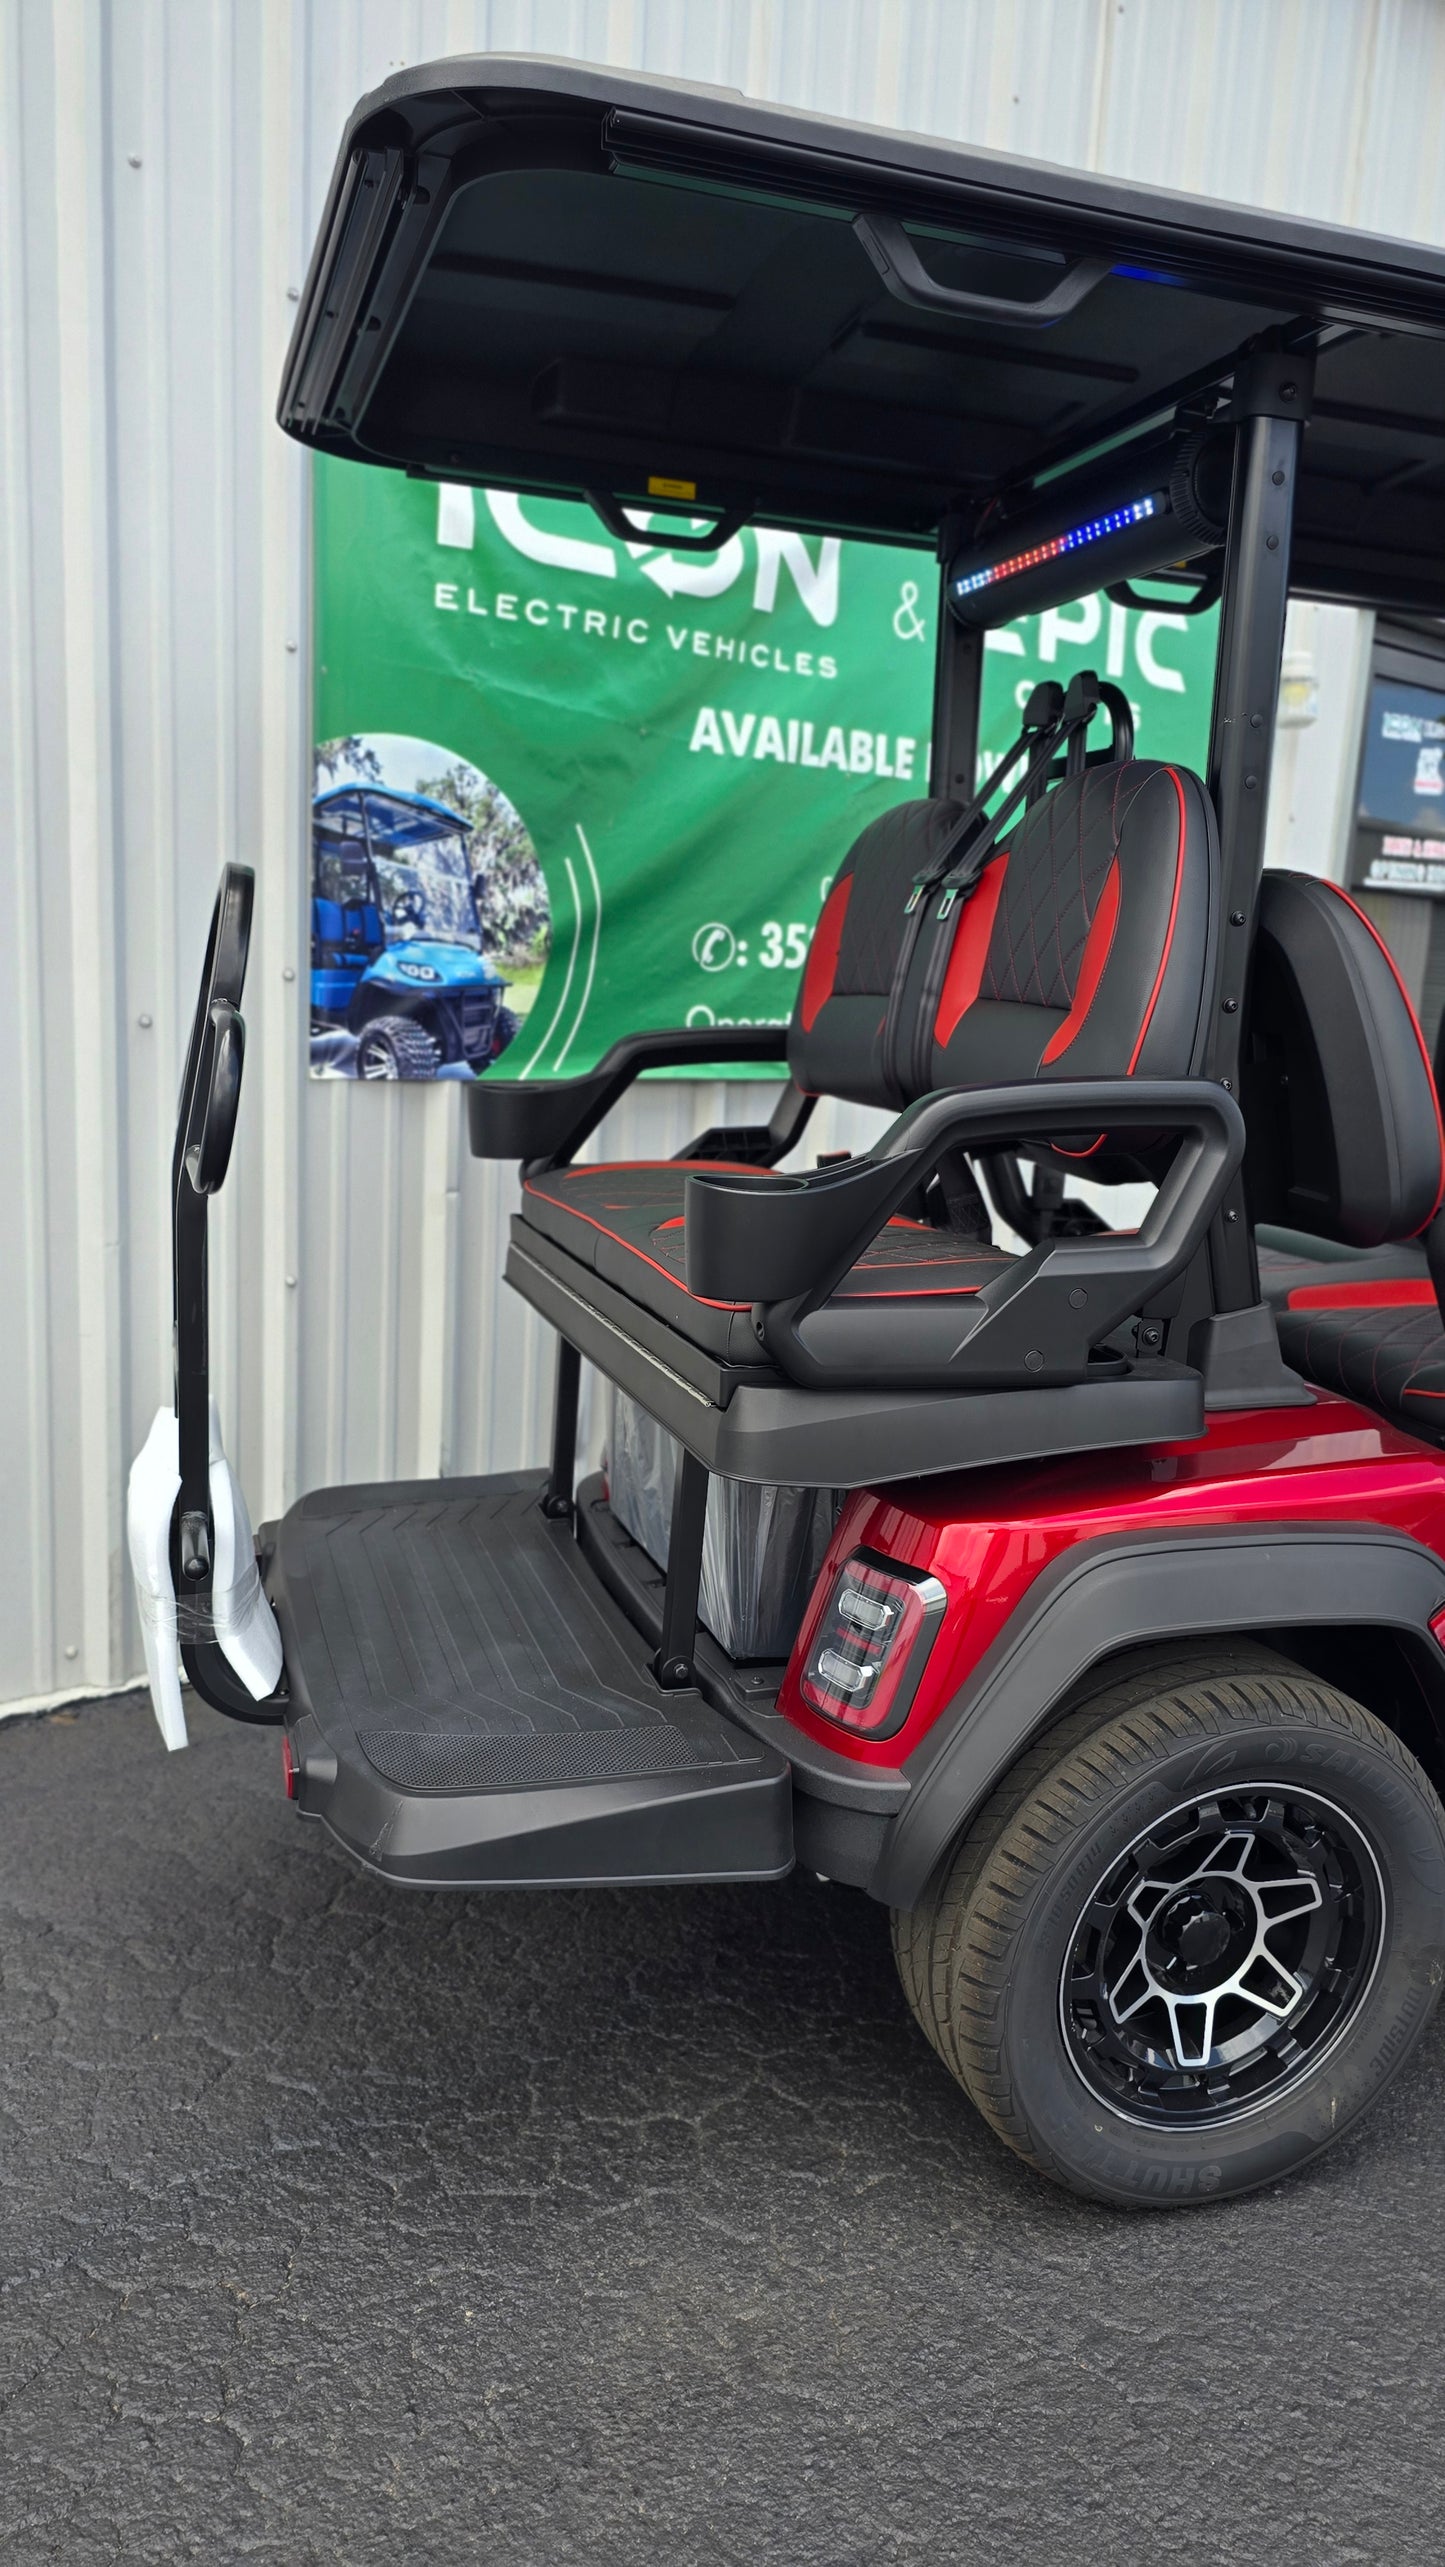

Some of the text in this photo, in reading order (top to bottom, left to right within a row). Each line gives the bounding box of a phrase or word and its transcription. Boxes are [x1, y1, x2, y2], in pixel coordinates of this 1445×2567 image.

[434, 582, 838, 679] ELECTRIC VEHICLES
[893, 580, 926, 642] &
[689, 706, 916, 780] AVAILABLE
[758, 921, 817, 970] 35
